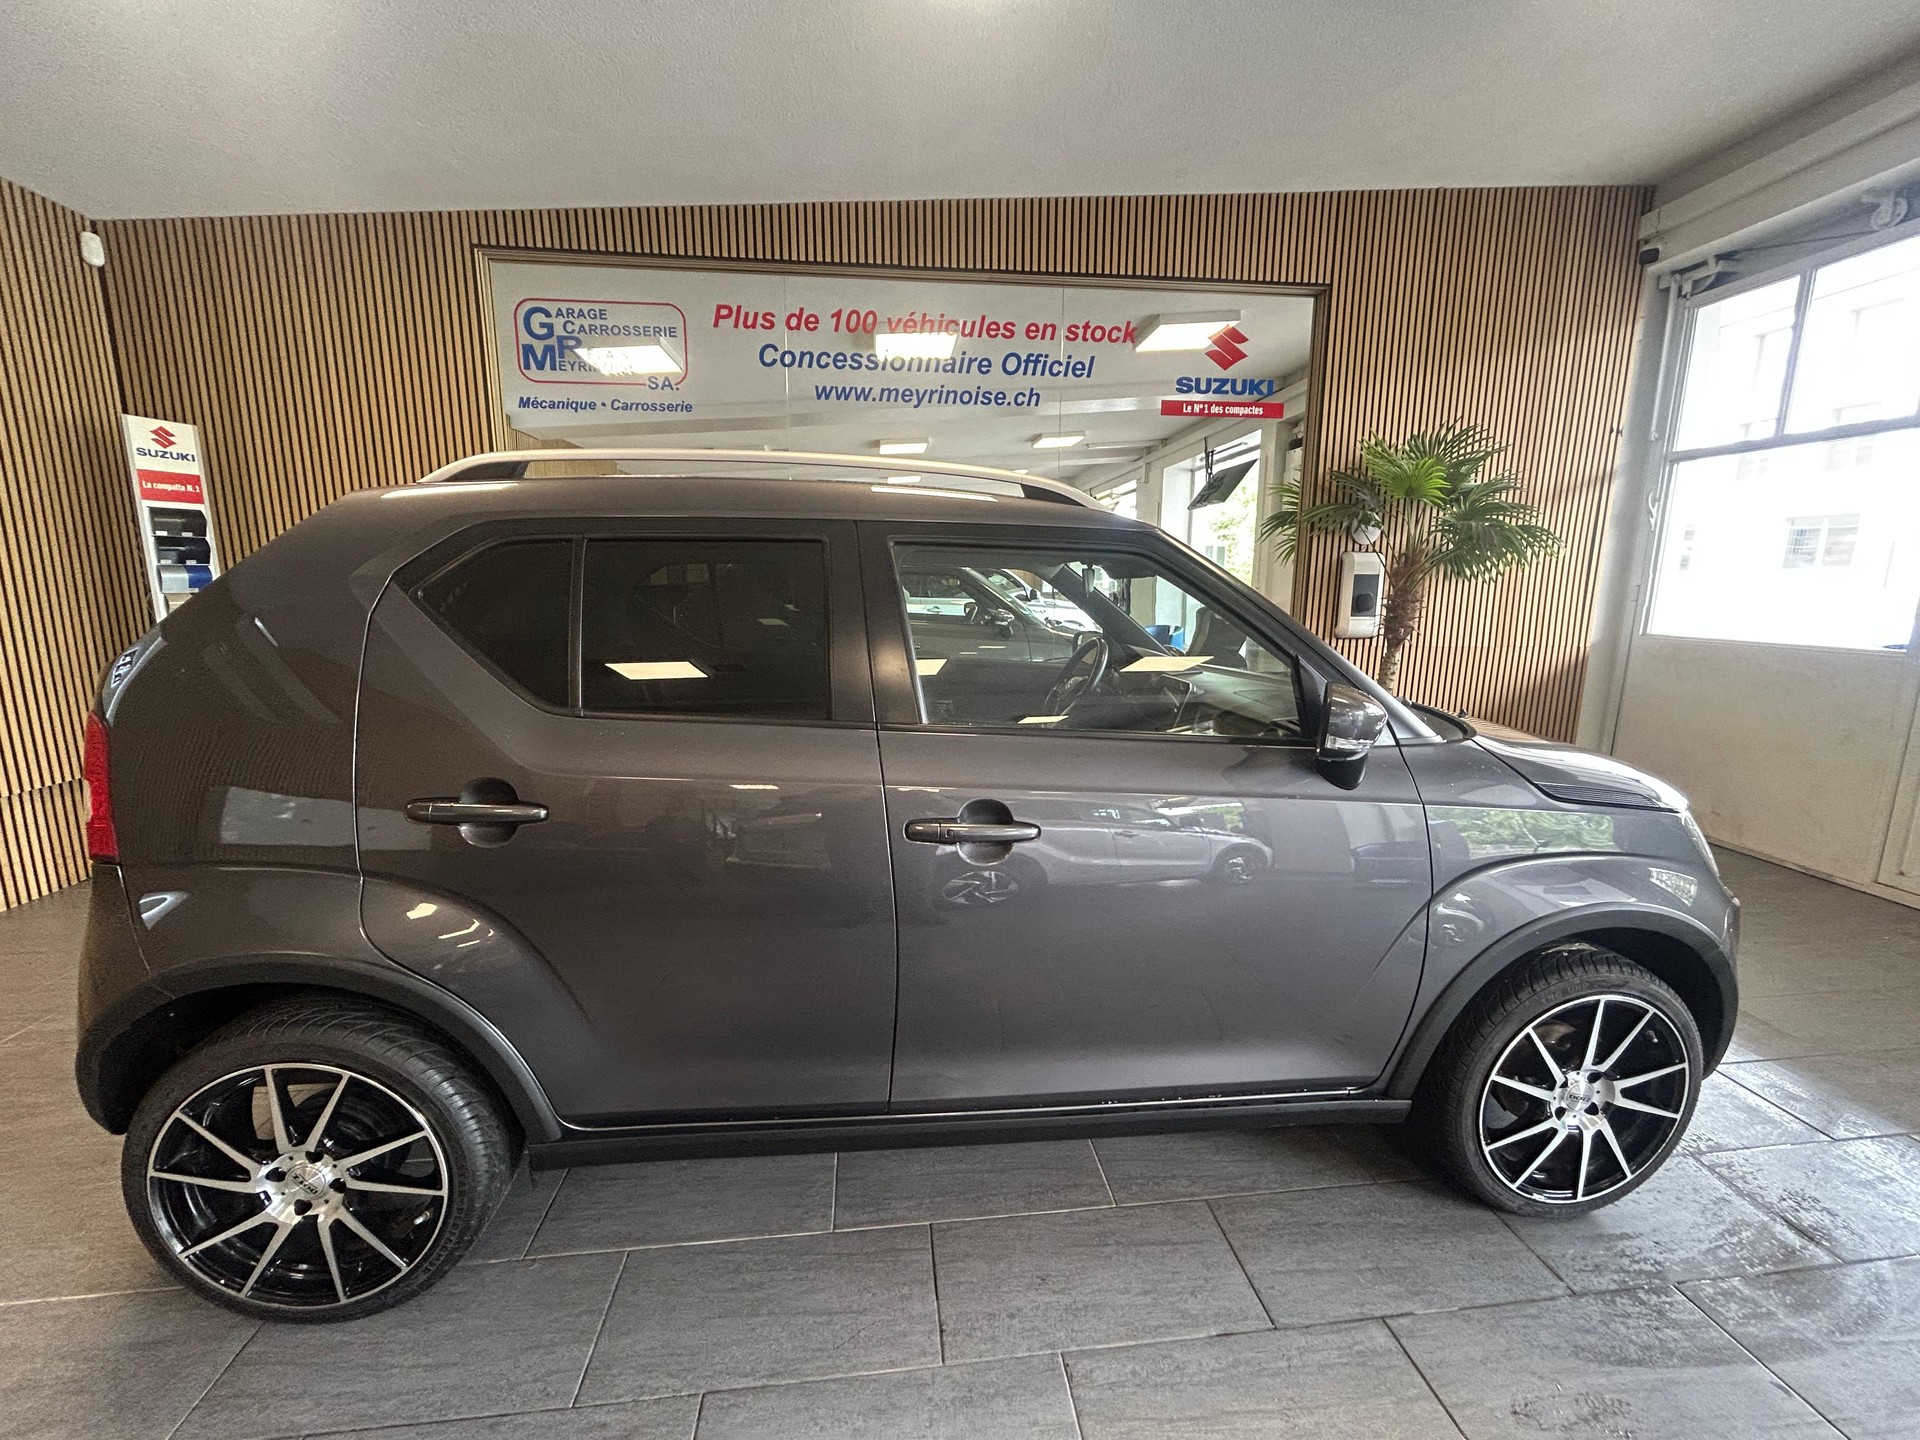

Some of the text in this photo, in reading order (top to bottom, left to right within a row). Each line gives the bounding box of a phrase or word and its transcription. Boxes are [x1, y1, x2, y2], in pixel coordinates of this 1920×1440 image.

[563, 320, 678, 338] CARROSSERIE
[713, 304, 1138, 344] Plus de 100 véhicules en stock
[759, 343, 1095, 378] Concessionnaire Officiel
[1175, 376, 1275, 396] SUZUKI
[518, 394, 693, 413] Mécanique Carrosserie
[815, 384, 1041, 408] www.meyrinoise.ch
[1183, 403, 1192, 413] Le
[1210, 403, 1223, 414] des
[1225, 404, 1264, 416] compactes
[136, 447, 196, 462] SUZUKI
